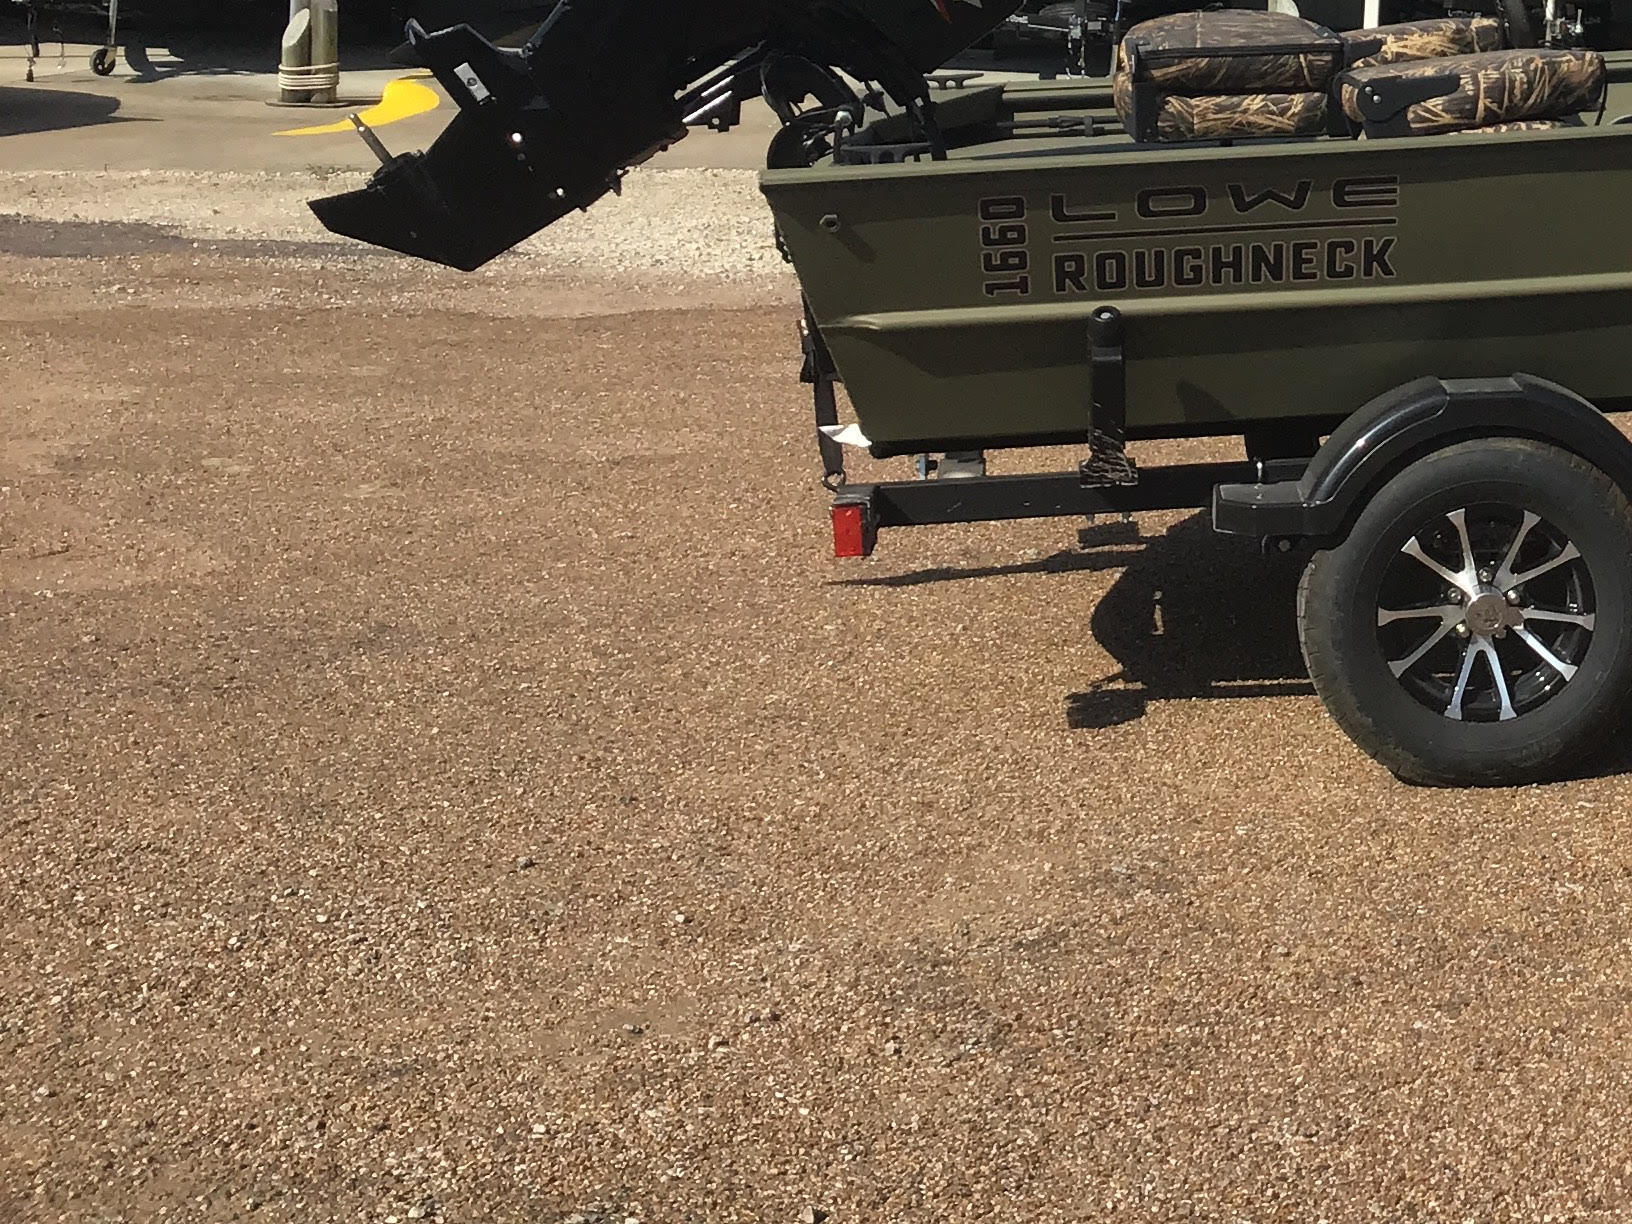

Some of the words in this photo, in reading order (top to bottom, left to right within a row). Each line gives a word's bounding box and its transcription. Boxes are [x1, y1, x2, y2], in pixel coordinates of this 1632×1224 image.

[1048, 176, 1400, 224] LOWE
[977, 195, 1029, 298] 1660
[1050, 236, 1400, 295] ROUGHNECK
